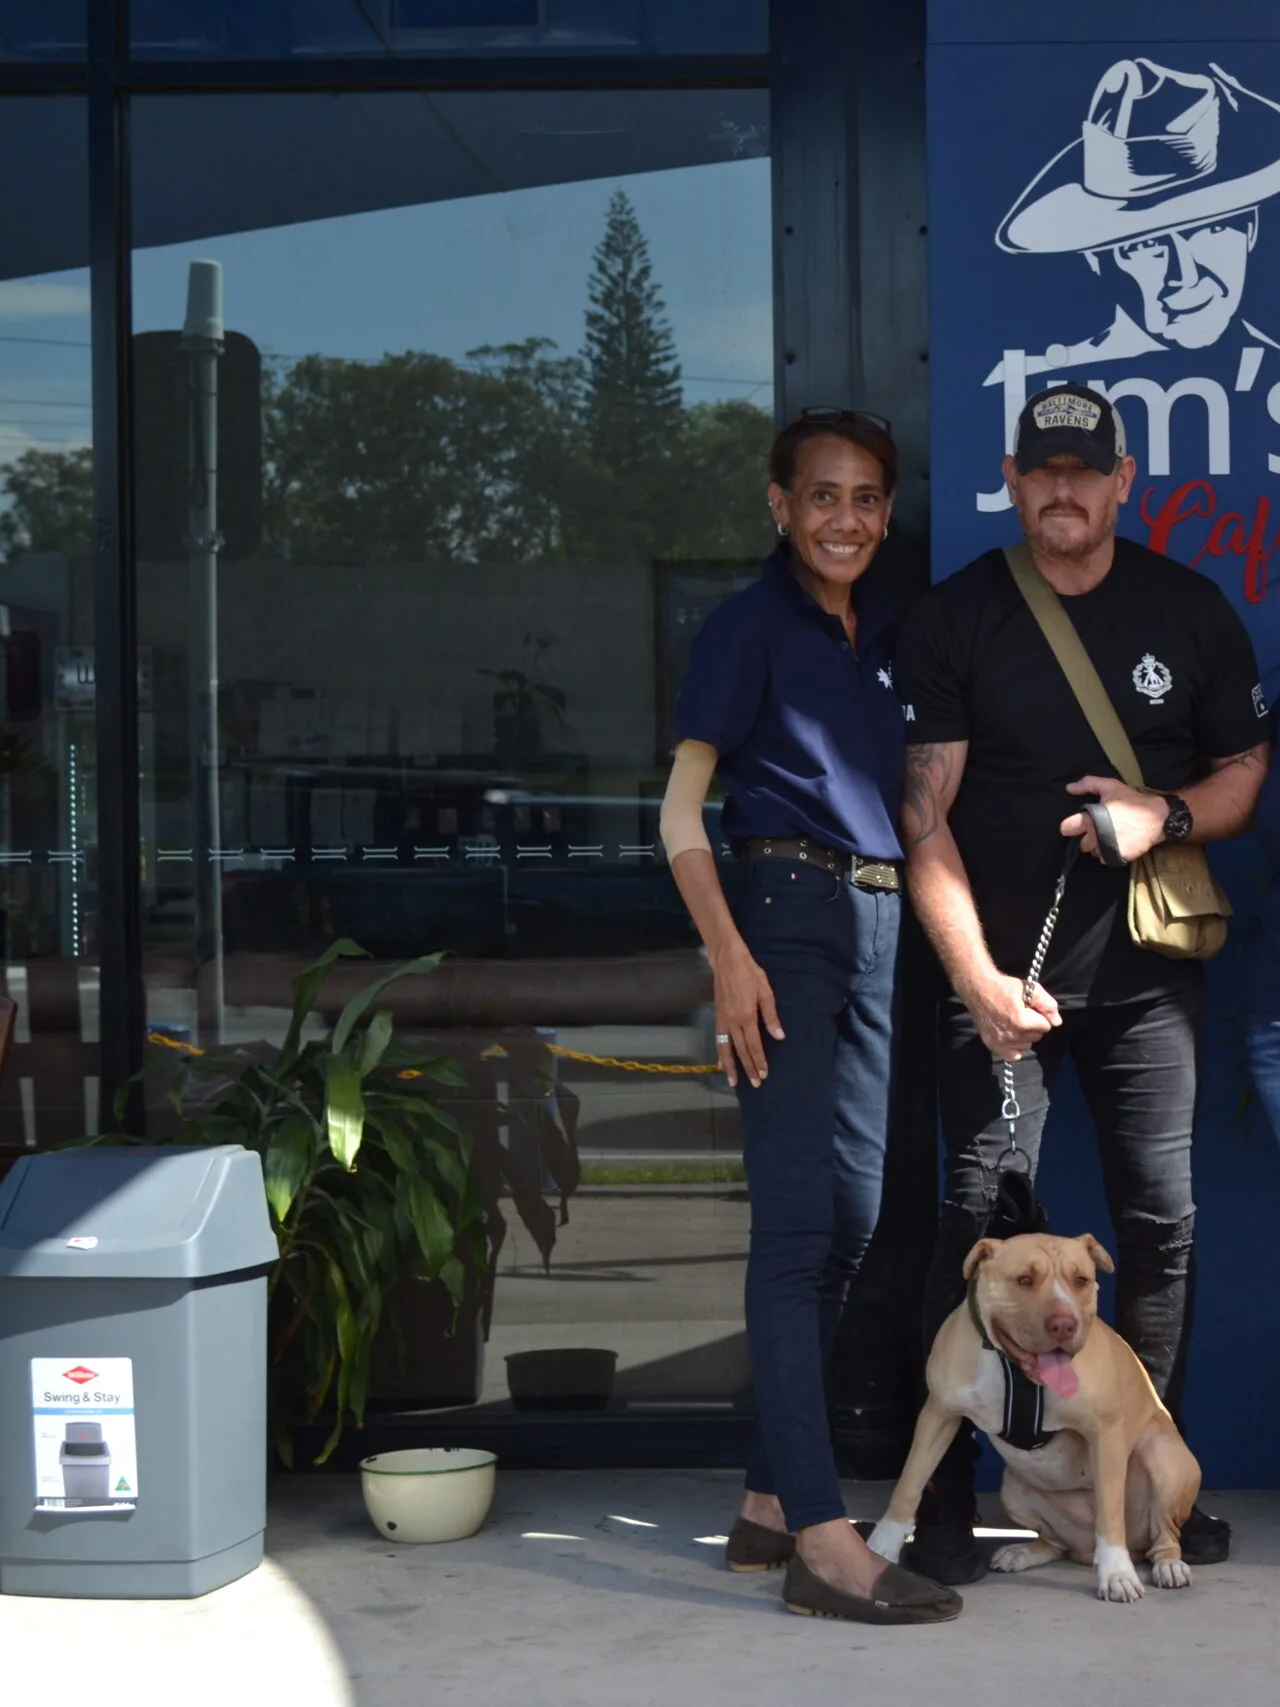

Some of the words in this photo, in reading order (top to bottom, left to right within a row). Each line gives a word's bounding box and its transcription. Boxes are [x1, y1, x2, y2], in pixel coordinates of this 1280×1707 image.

[1042, 396, 1093, 412] BALTIMORE
[1044, 416, 1089, 428] RAVENS
[44, 1391, 80, 1405] Swing
[82, 1391, 91, 1402] &
[94, 1391, 121, 1405] Stay
